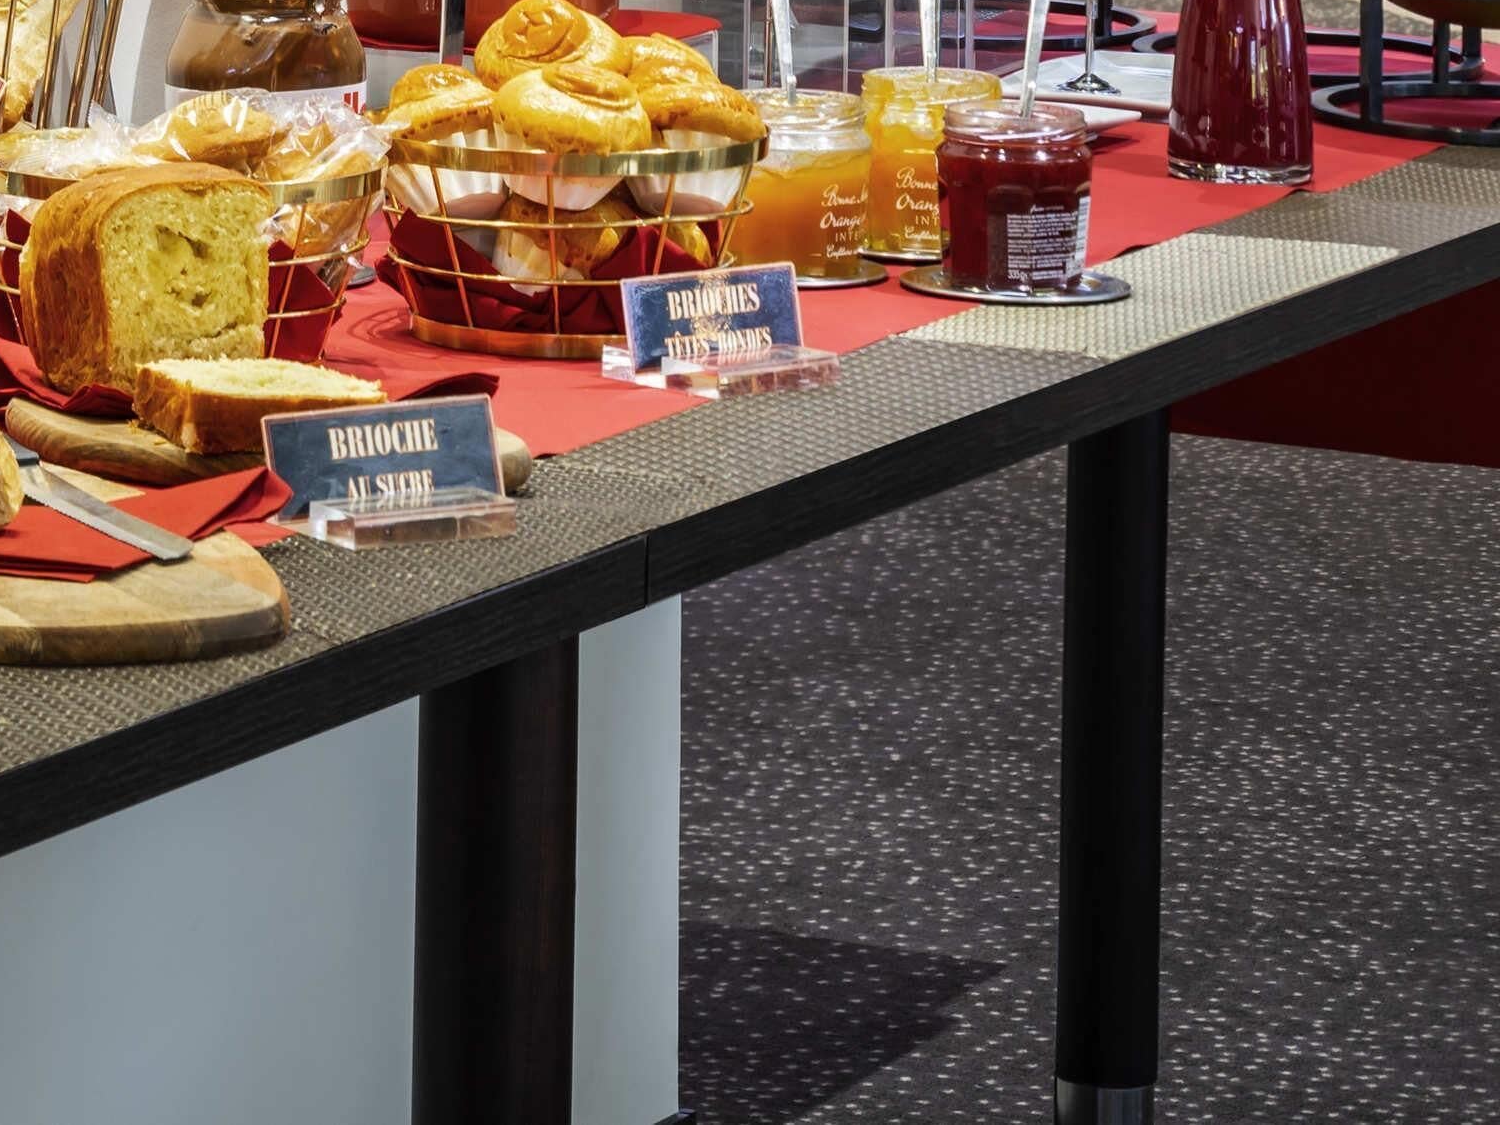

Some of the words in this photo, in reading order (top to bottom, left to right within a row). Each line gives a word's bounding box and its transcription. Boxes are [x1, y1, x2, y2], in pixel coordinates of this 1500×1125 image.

[666, 282, 760, 321] BRIOCHES
[718, 326, 773, 355] RONDES
[327, 418, 439, 461] BRIOCHE
[348, 475, 372, 500] AU
[375, 469, 435, 495] SUCRE
